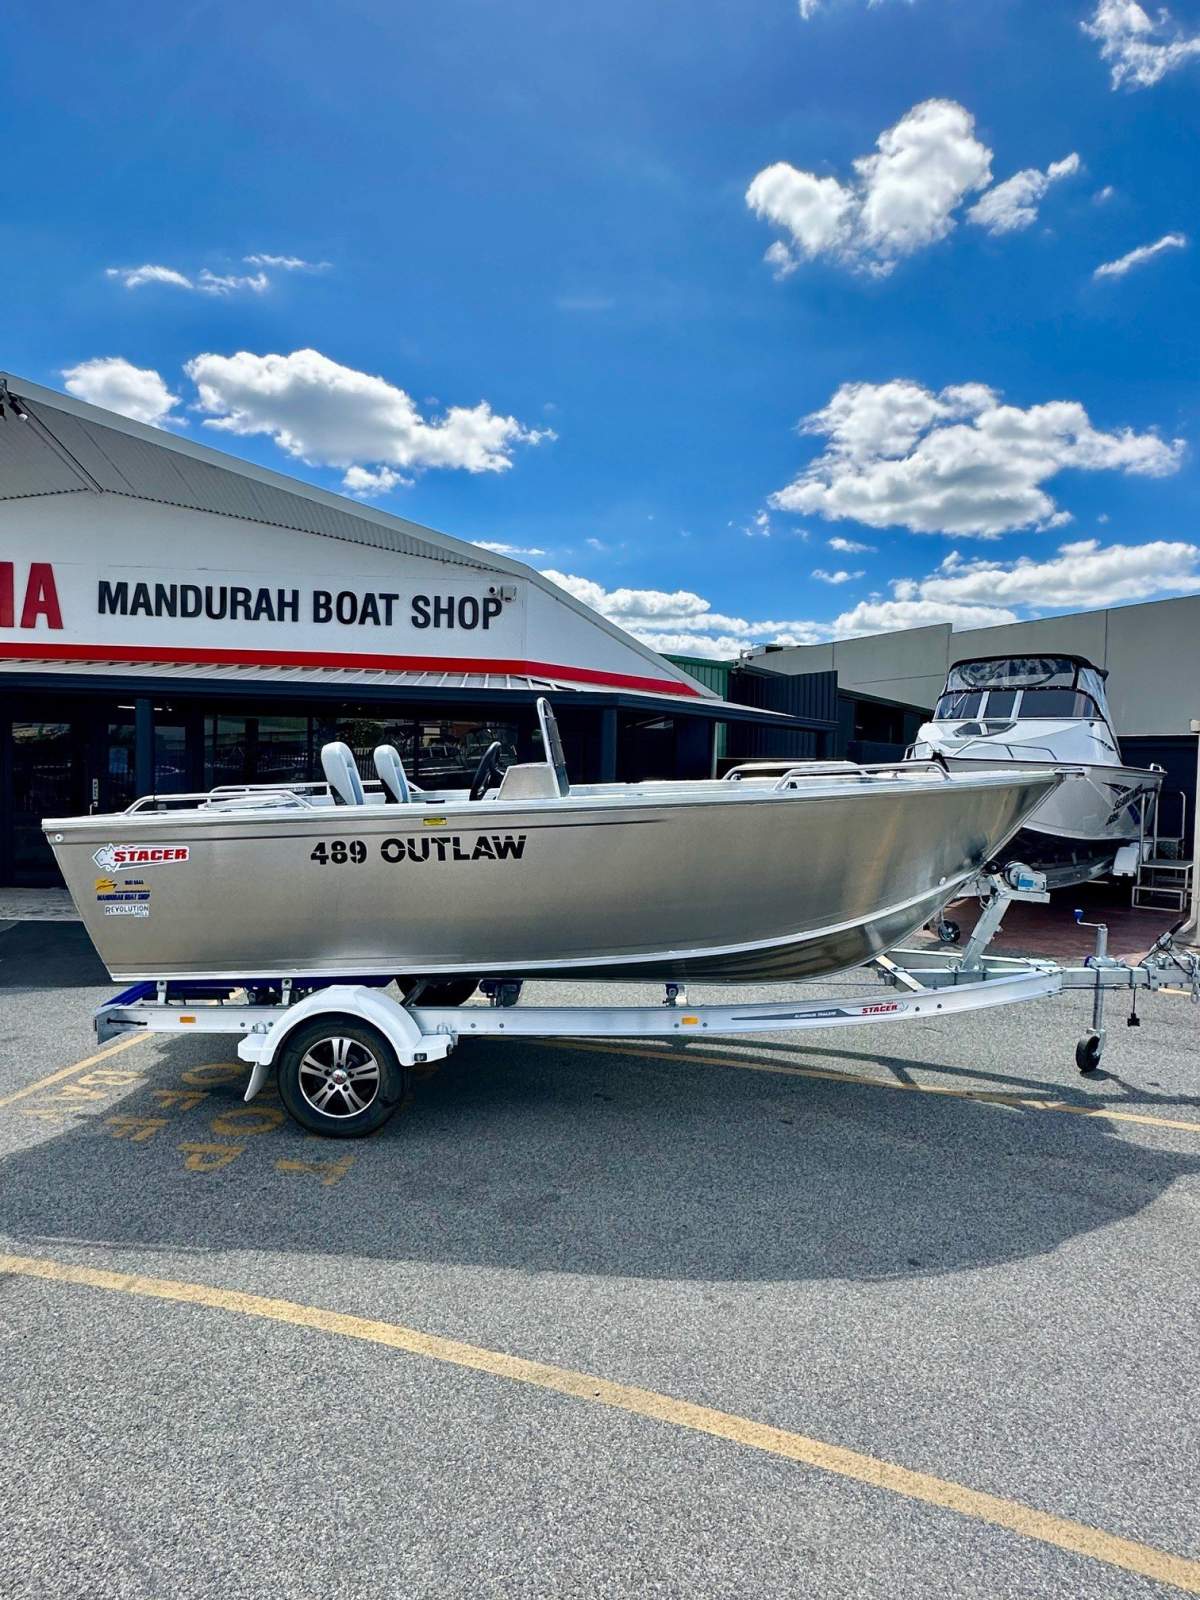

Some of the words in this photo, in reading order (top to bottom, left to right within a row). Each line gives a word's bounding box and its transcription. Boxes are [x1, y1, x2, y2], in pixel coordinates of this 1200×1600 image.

[98, 580, 300, 623] MANDURAH
[312, 590, 399, 627] BOAT
[411, 595, 503, 630] SHOP
[114, 849, 187, 862] STACER
[310, 839, 368, 865] 489
[380, 834, 527, 864] OUTLAW
[105, 905, 149, 913] REVOLUTION
[863, 1004, 898, 1013] STACER
